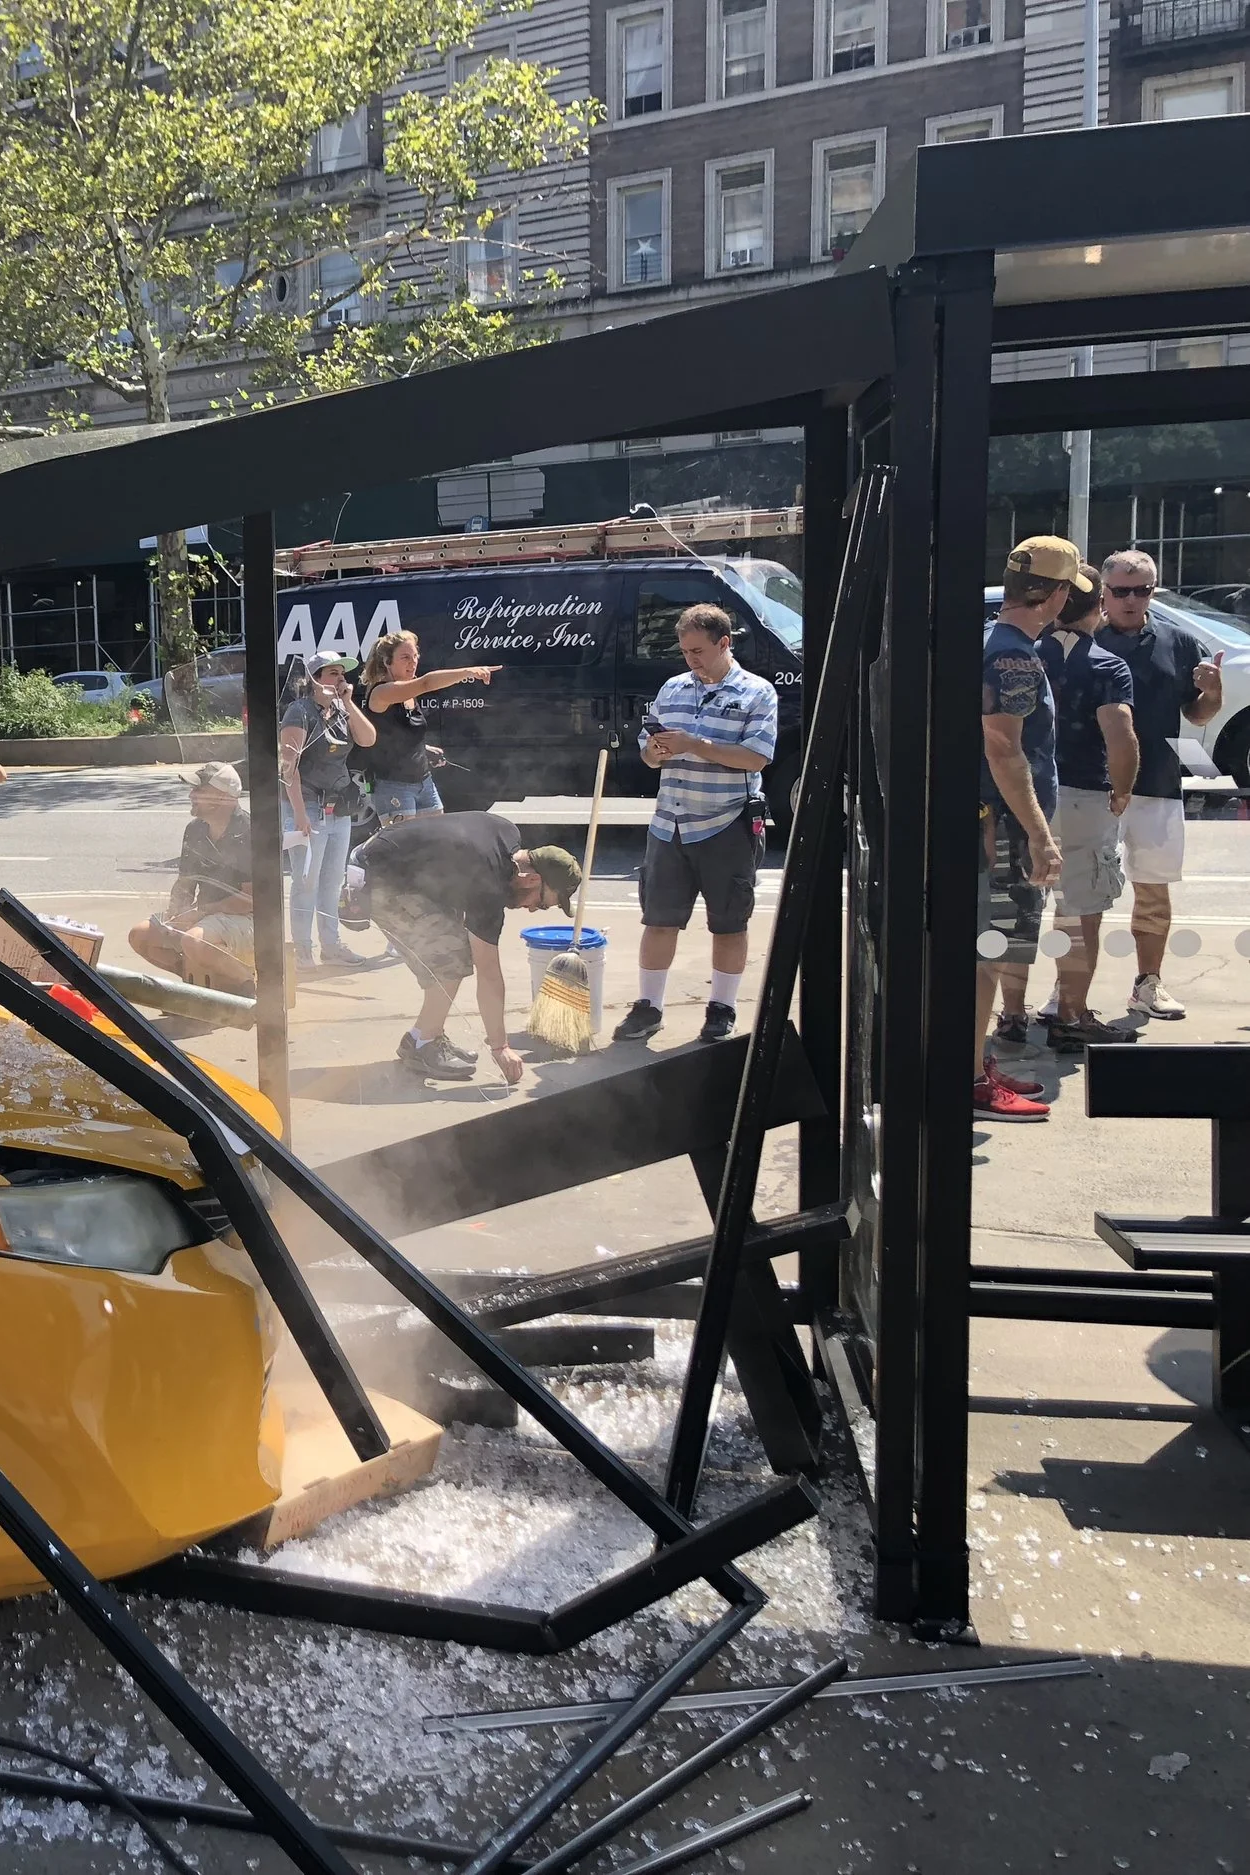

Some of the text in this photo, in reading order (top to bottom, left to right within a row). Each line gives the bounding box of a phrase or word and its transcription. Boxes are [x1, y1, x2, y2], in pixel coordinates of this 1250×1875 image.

[454, 595, 603, 628] Refrigeration
[277, 600, 402, 665] AAA
[455, 622, 596, 652] Service, Inc.
[421, 698, 440, 709] LIC.
[452, 698, 485, 709] P-1509
